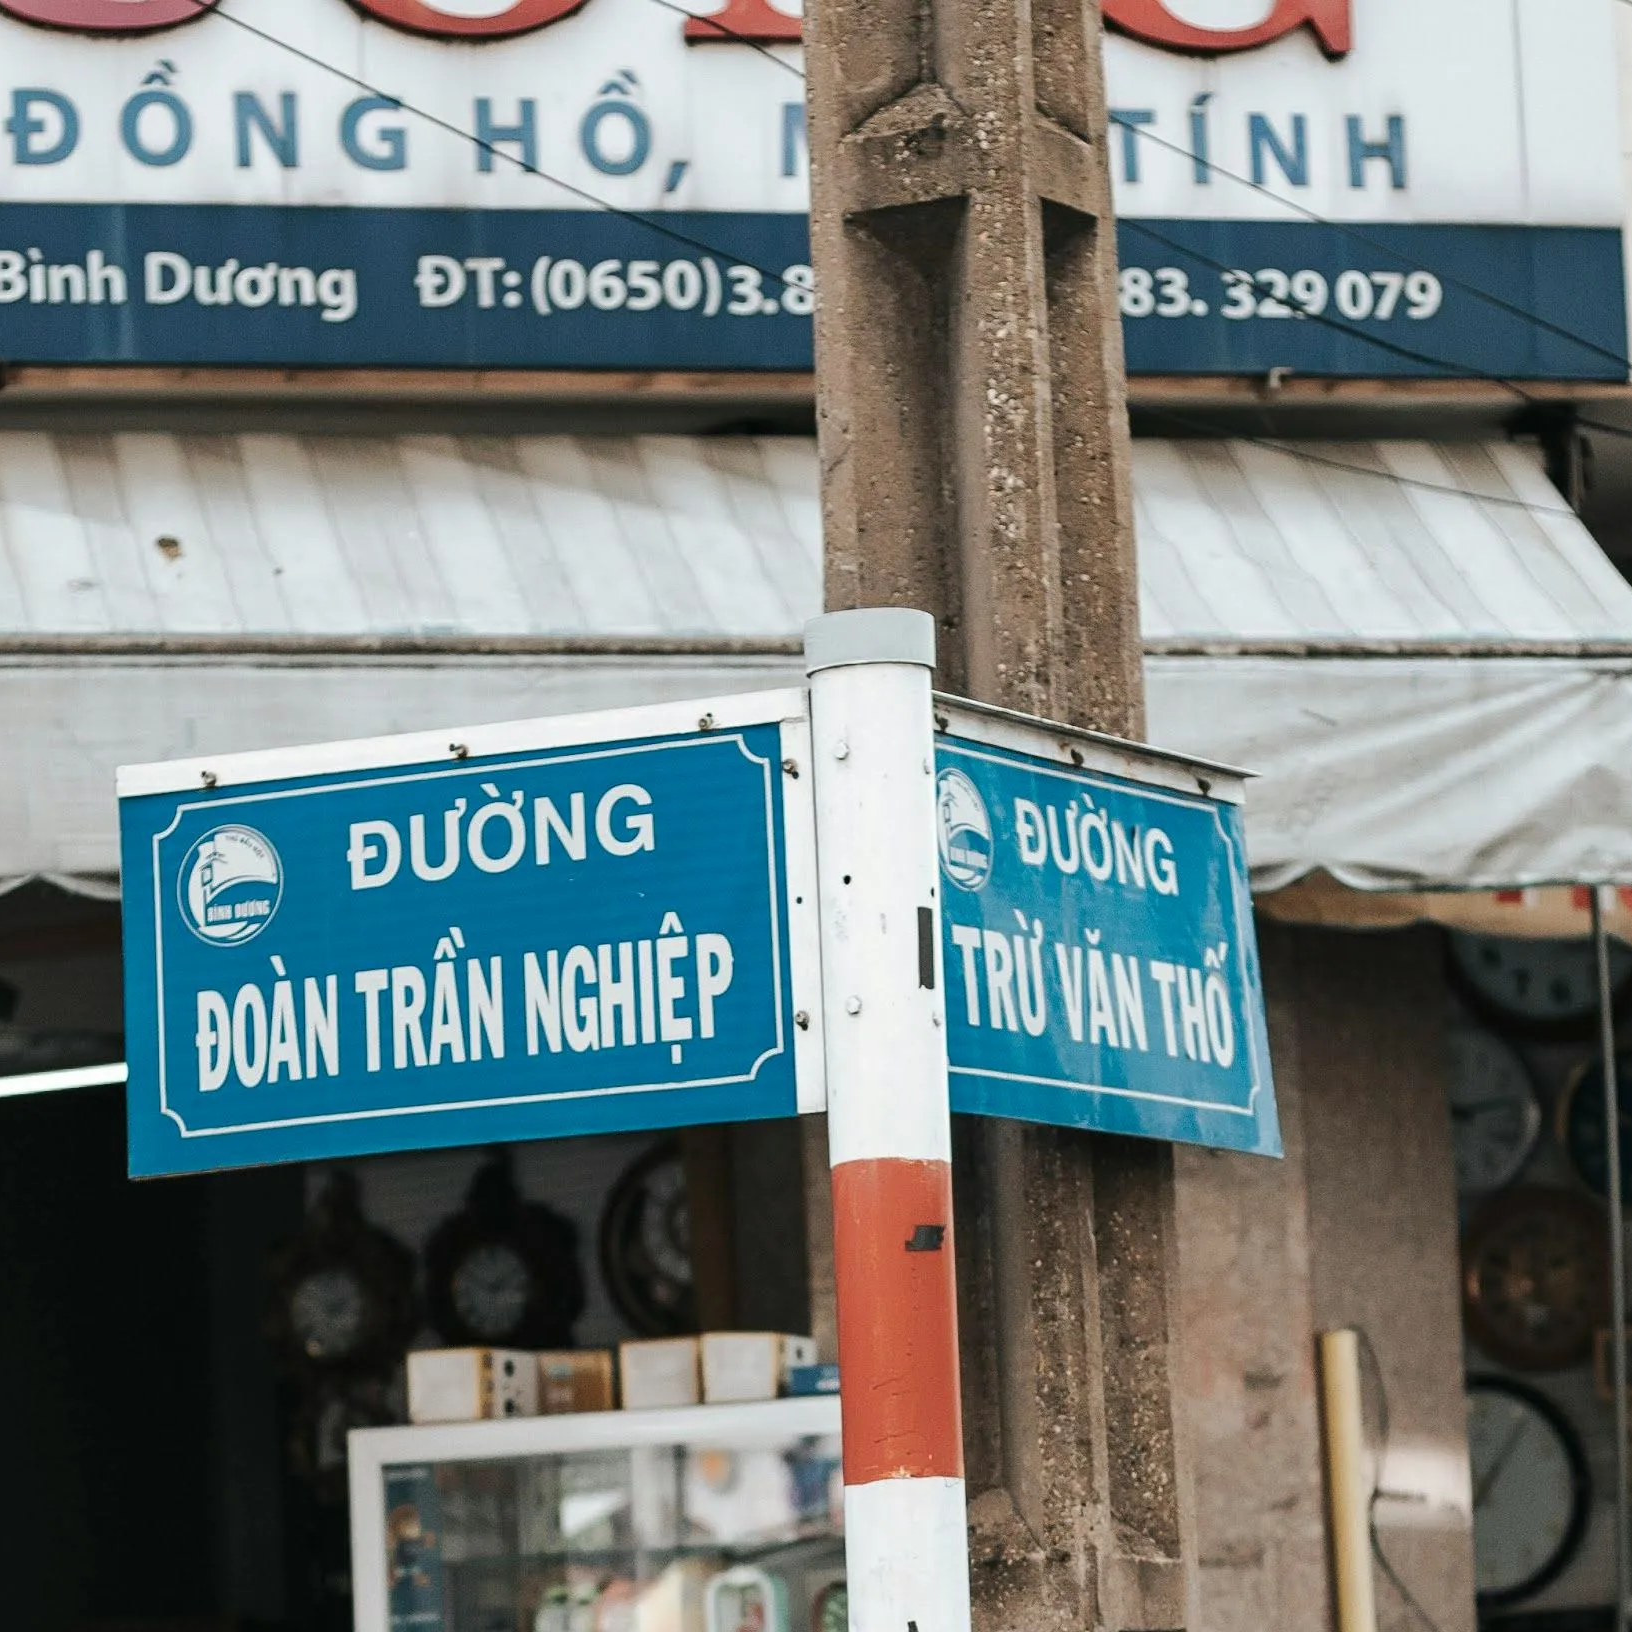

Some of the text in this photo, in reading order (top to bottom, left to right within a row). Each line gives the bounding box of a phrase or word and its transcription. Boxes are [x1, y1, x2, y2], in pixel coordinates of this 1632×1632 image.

[5, 62, 407, 172] ĐỒNG
[475, 69, 687, 192] HỒ,
[1110, 91, 1406, 188] TÍNH
[145, 252, 357, 323] Dương
[347, 784, 655, 890] ĐƯỜNG
[1015, 793, 1179, 895] ĐƯỜNG
[195, 911, 735, 1091] ĐOÀN TRẦN NGHIỆP
[951, 909, 1234, 1069] TRỪ VĂN THỐ
